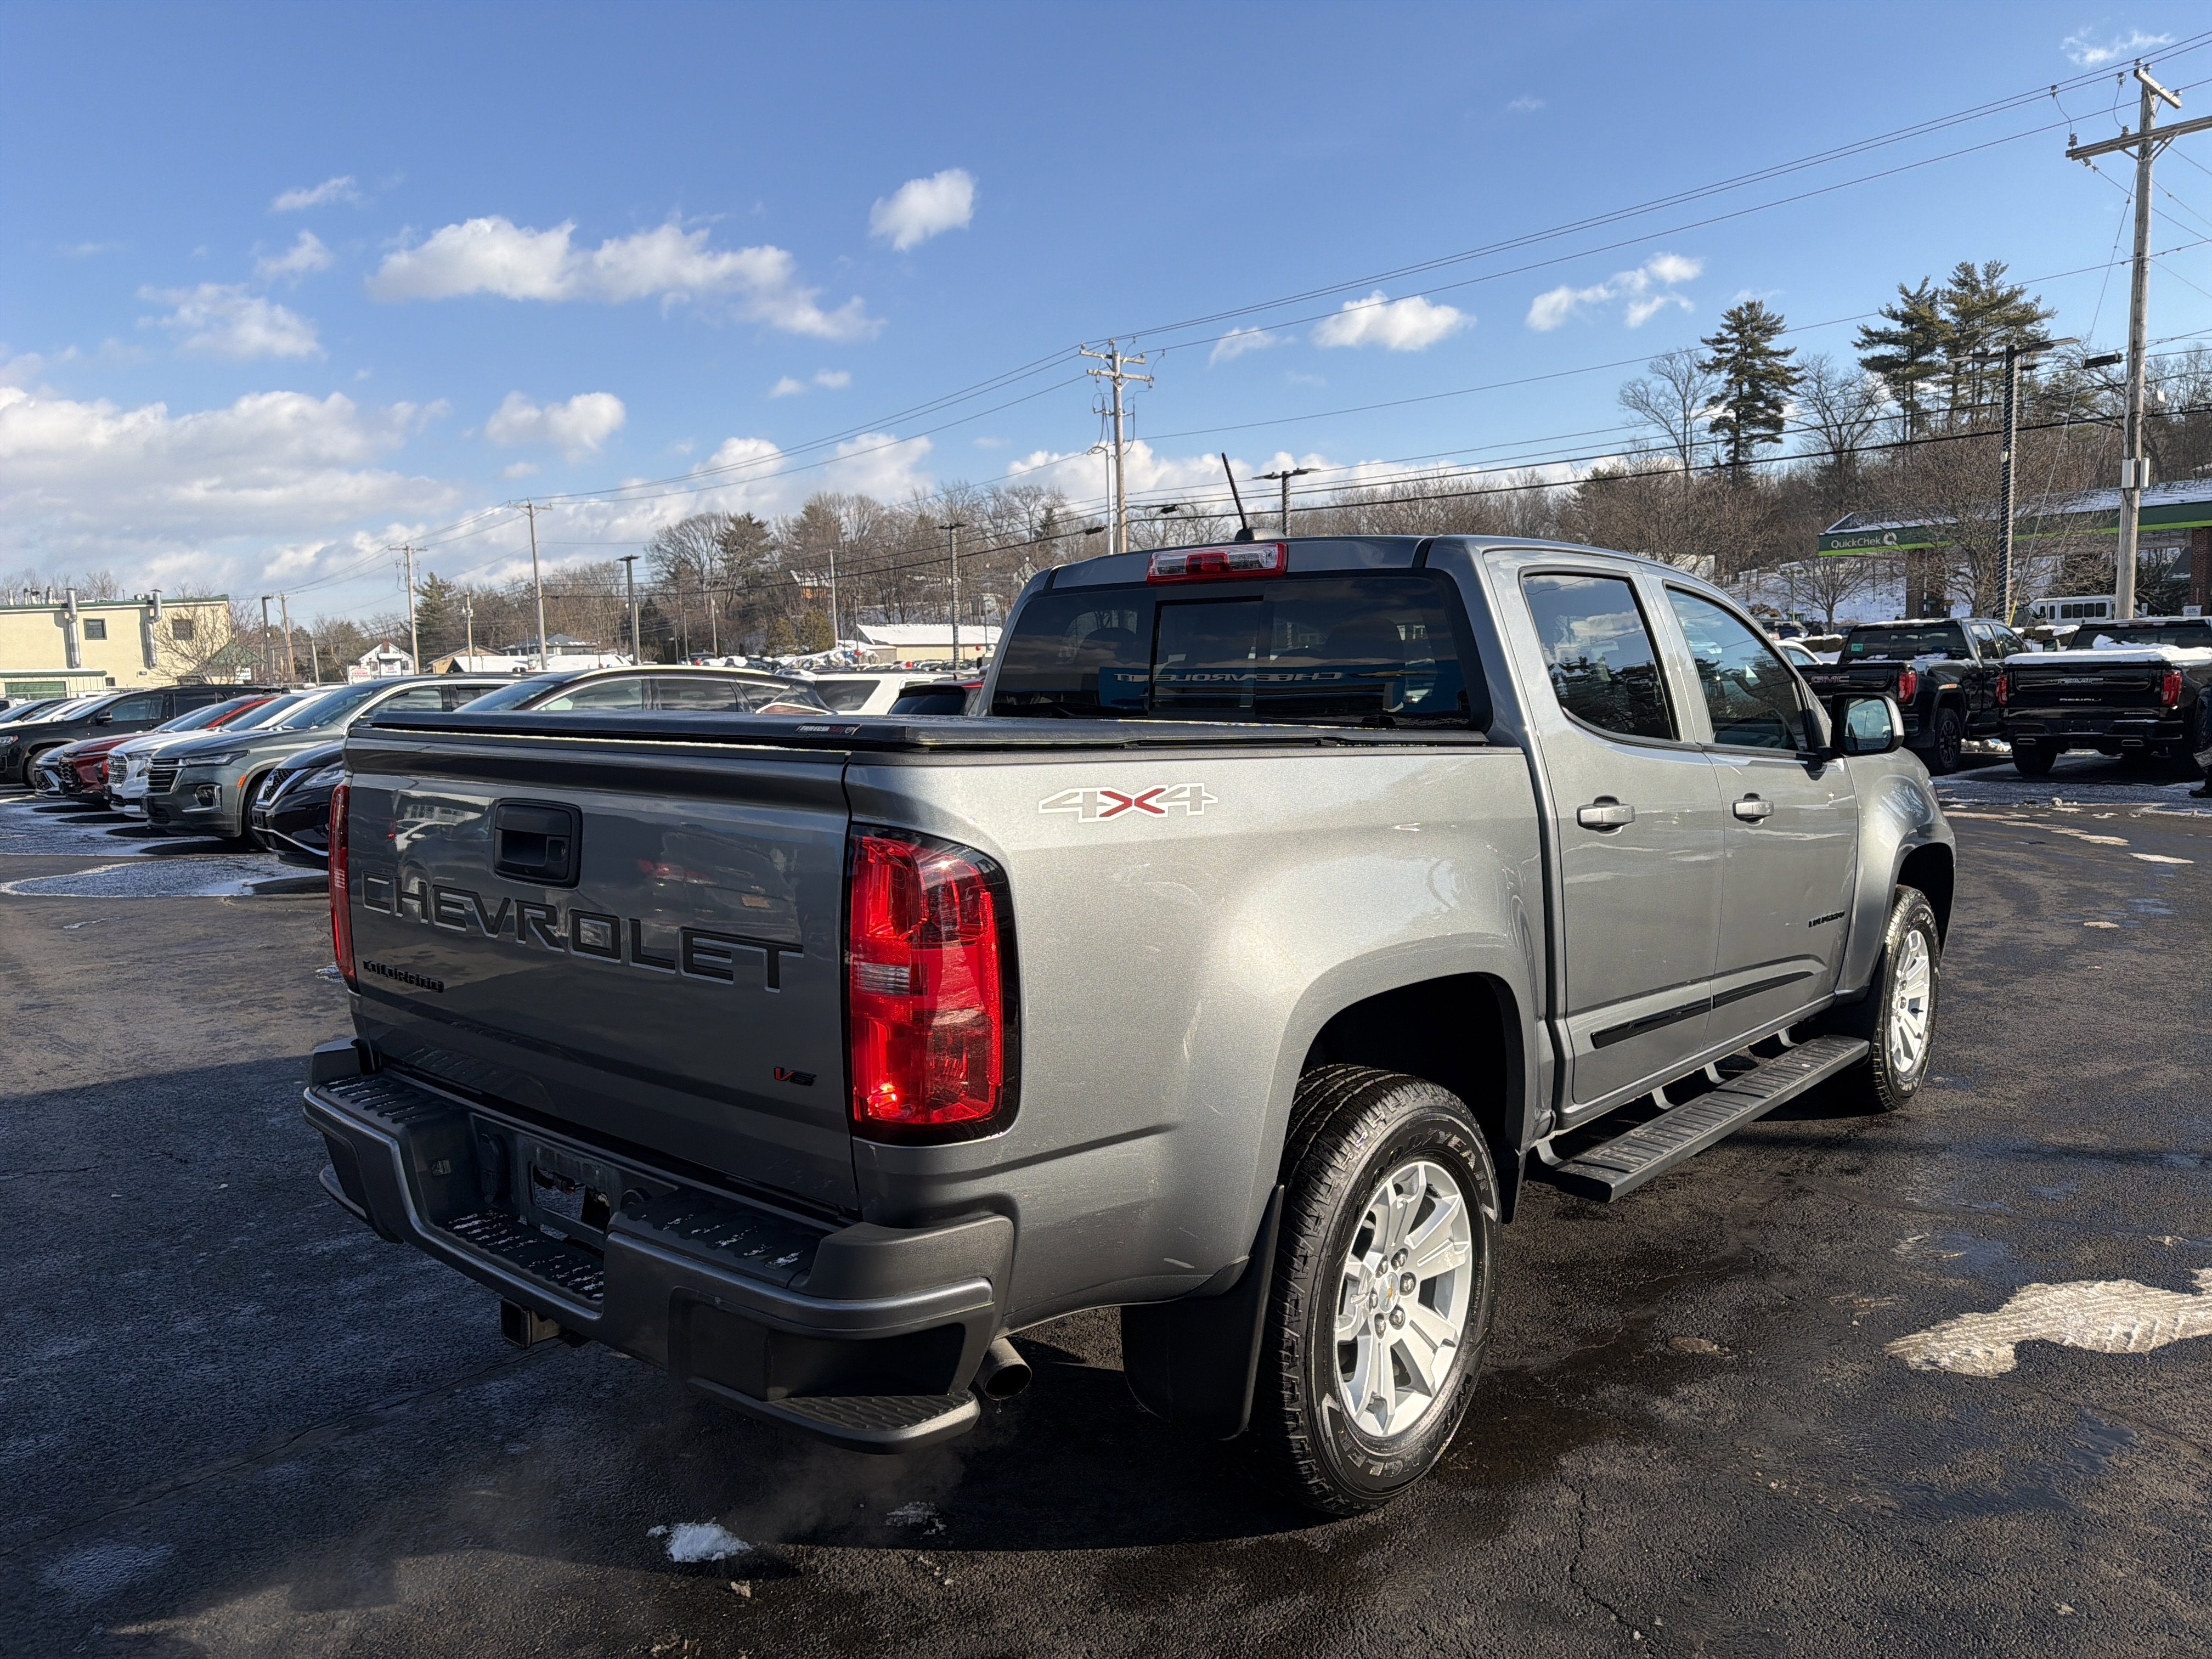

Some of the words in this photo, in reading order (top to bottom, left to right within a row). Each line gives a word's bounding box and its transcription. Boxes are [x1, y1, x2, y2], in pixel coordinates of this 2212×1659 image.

[1831, 536, 1882, 549] QuickChek
[1812, 675, 1850, 684] GMC
[2058, 678, 2104, 686] GMC
[362, 870, 804, 994] CHEVROLET
[774, 1066, 817, 1087] V6
